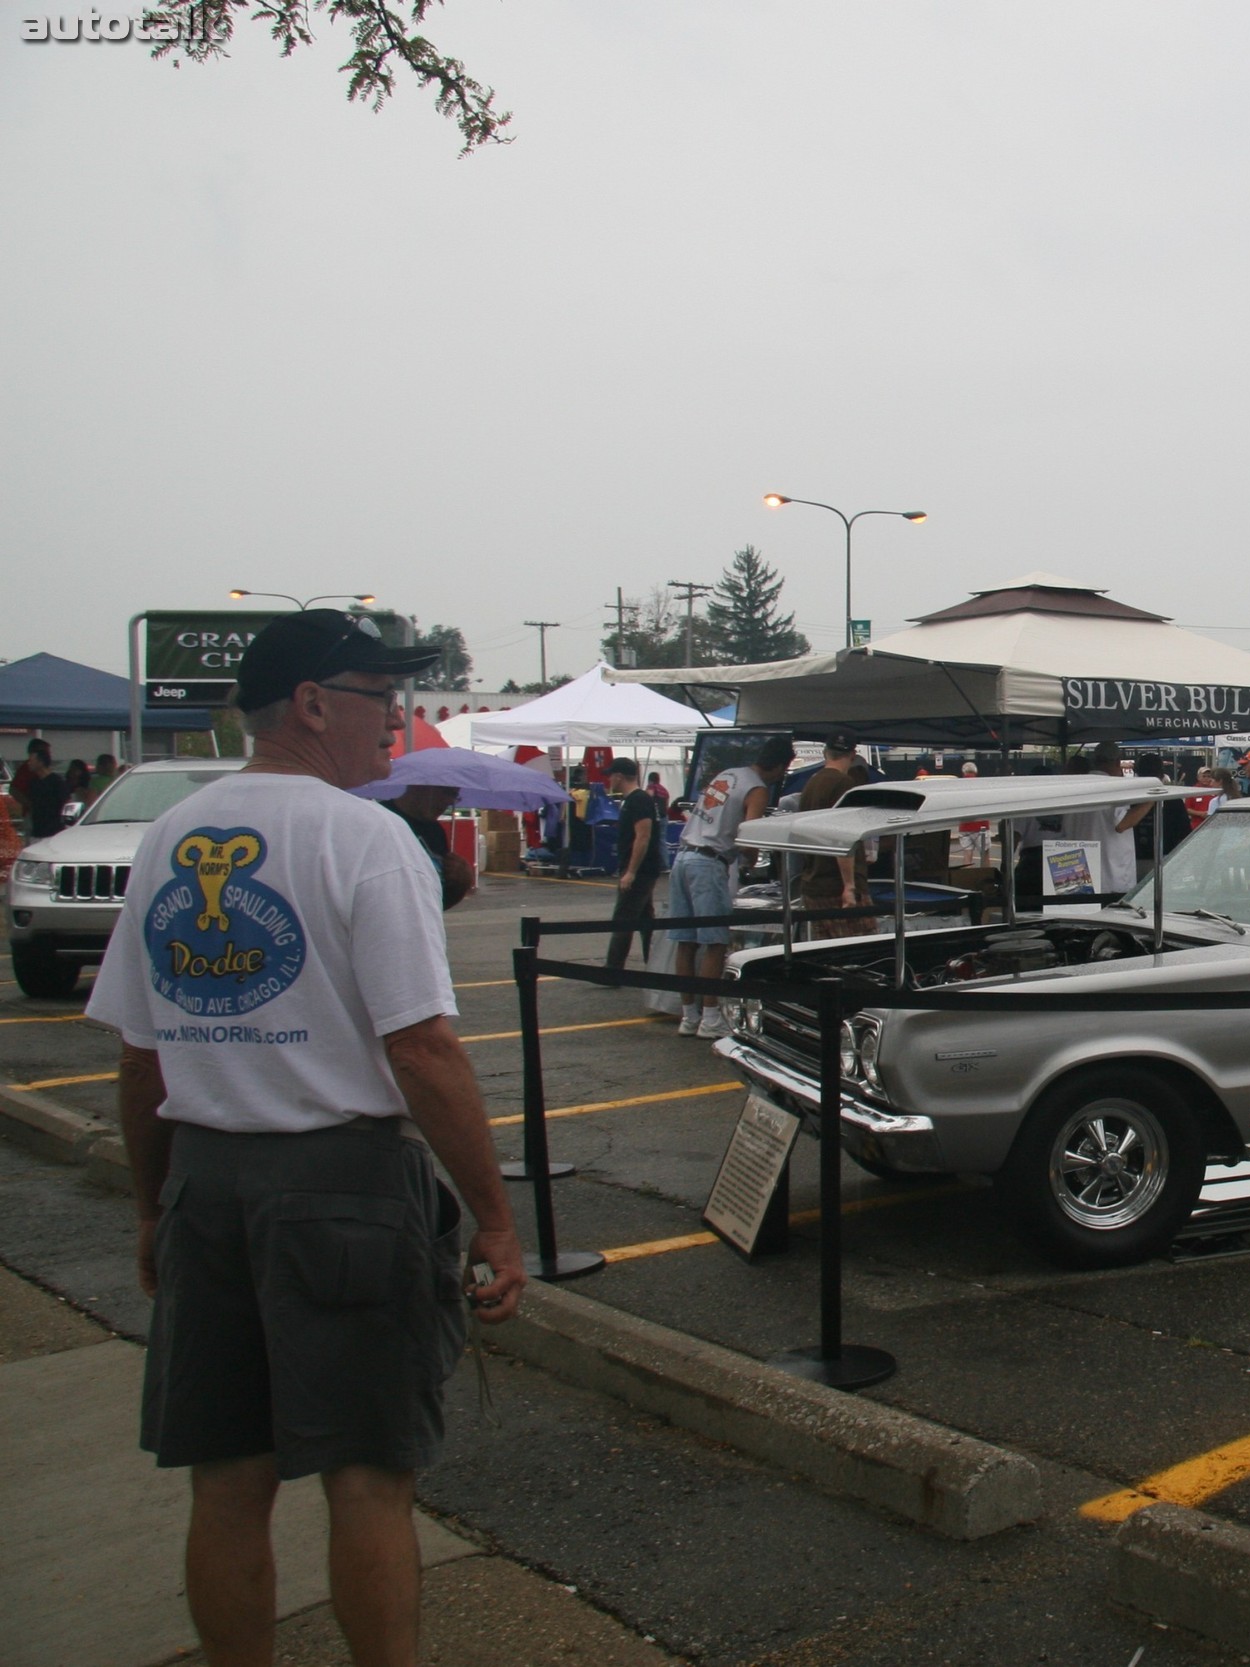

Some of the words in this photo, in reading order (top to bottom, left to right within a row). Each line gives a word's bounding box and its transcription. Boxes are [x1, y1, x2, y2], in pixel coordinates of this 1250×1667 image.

[153, 686, 186, 699] Jeep
[1066, 679, 1179, 712] SILVER
[1146, 717, 1239, 731] MERCHANDISE
[209, 846, 224, 859] MR.
[200, 862, 230, 876] NORM'S
[153, 886, 194, 931] GRAND
[224, 885, 297, 947] SPAULDING
[206, 997, 237, 1014] AVE.
